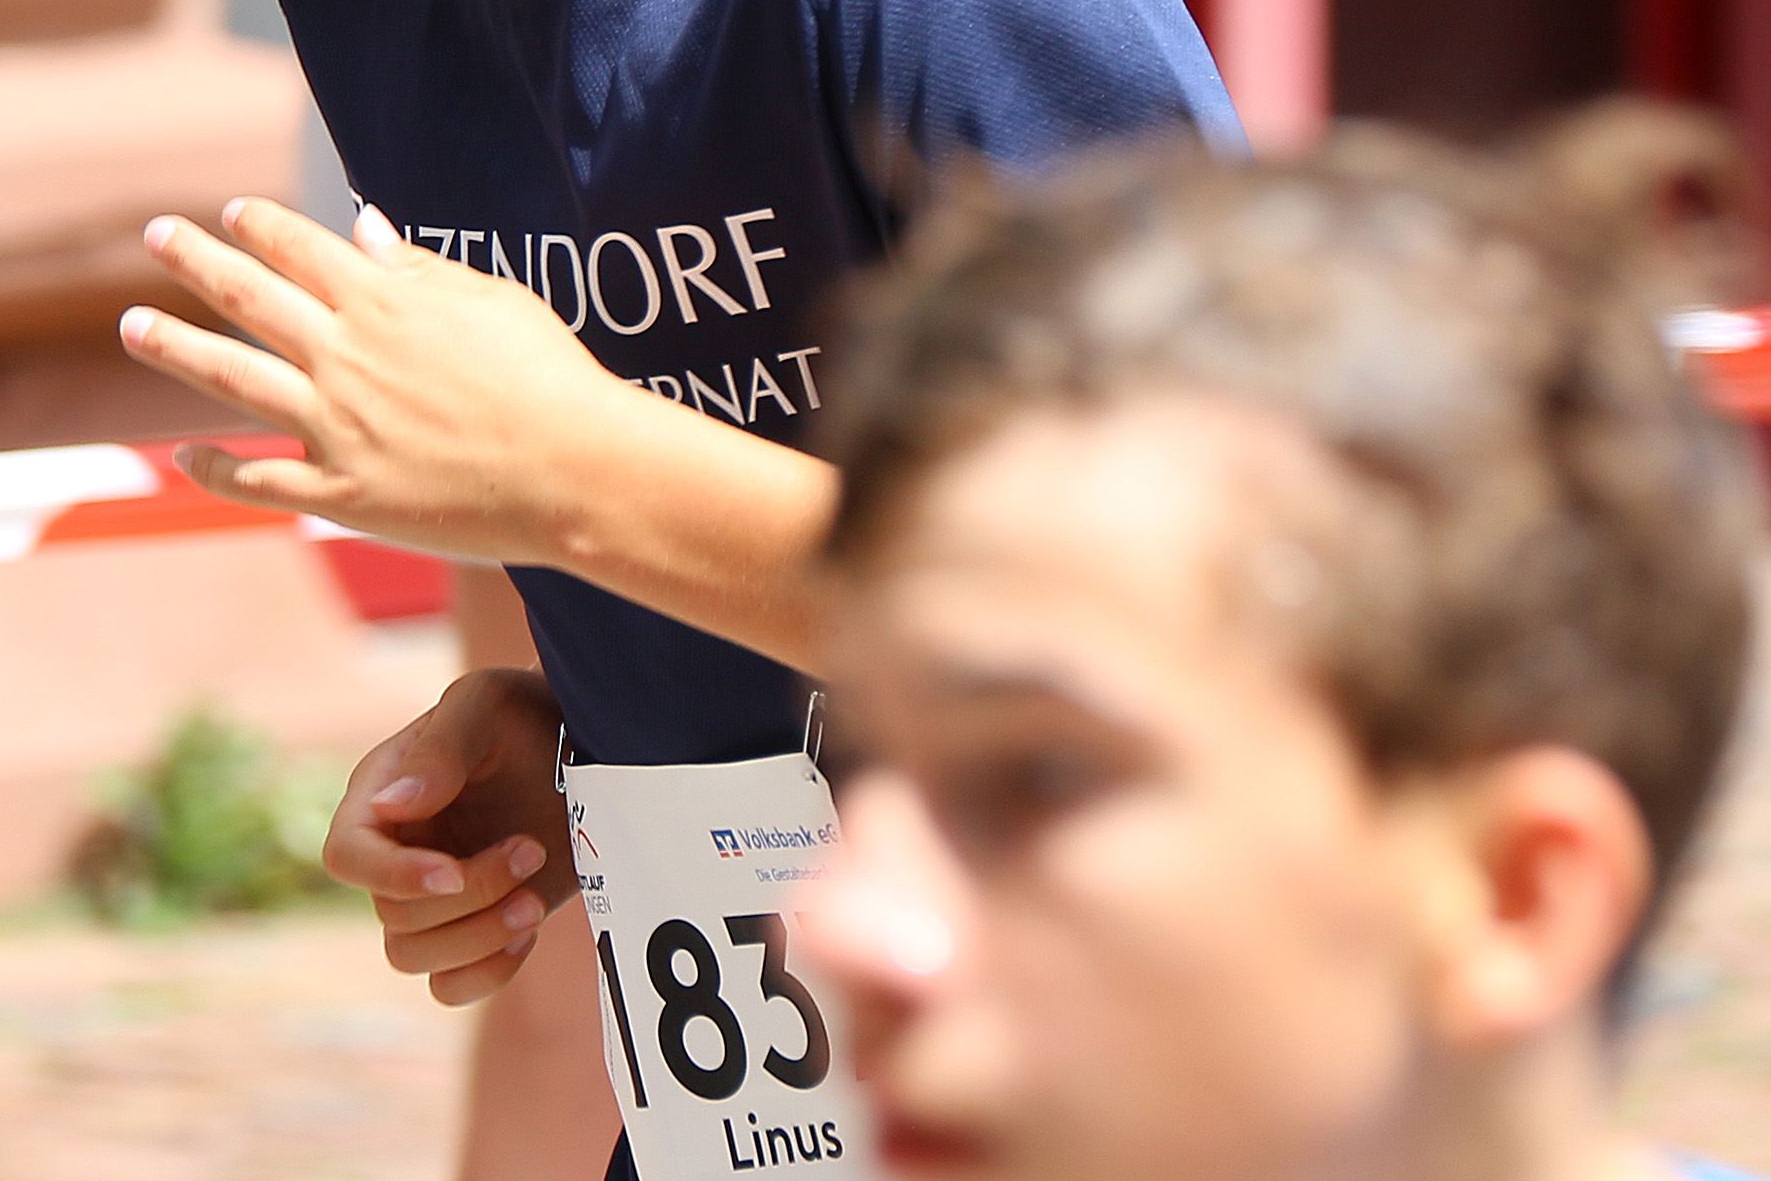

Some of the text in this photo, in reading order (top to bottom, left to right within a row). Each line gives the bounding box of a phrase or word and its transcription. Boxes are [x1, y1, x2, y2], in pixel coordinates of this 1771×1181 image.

[627, 346, 822, 426] RNAT
[737, 824, 818, 850] Volksbank
[596, 912, 873, 1109] 183
[722, 1111, 845, 1171] Linus
